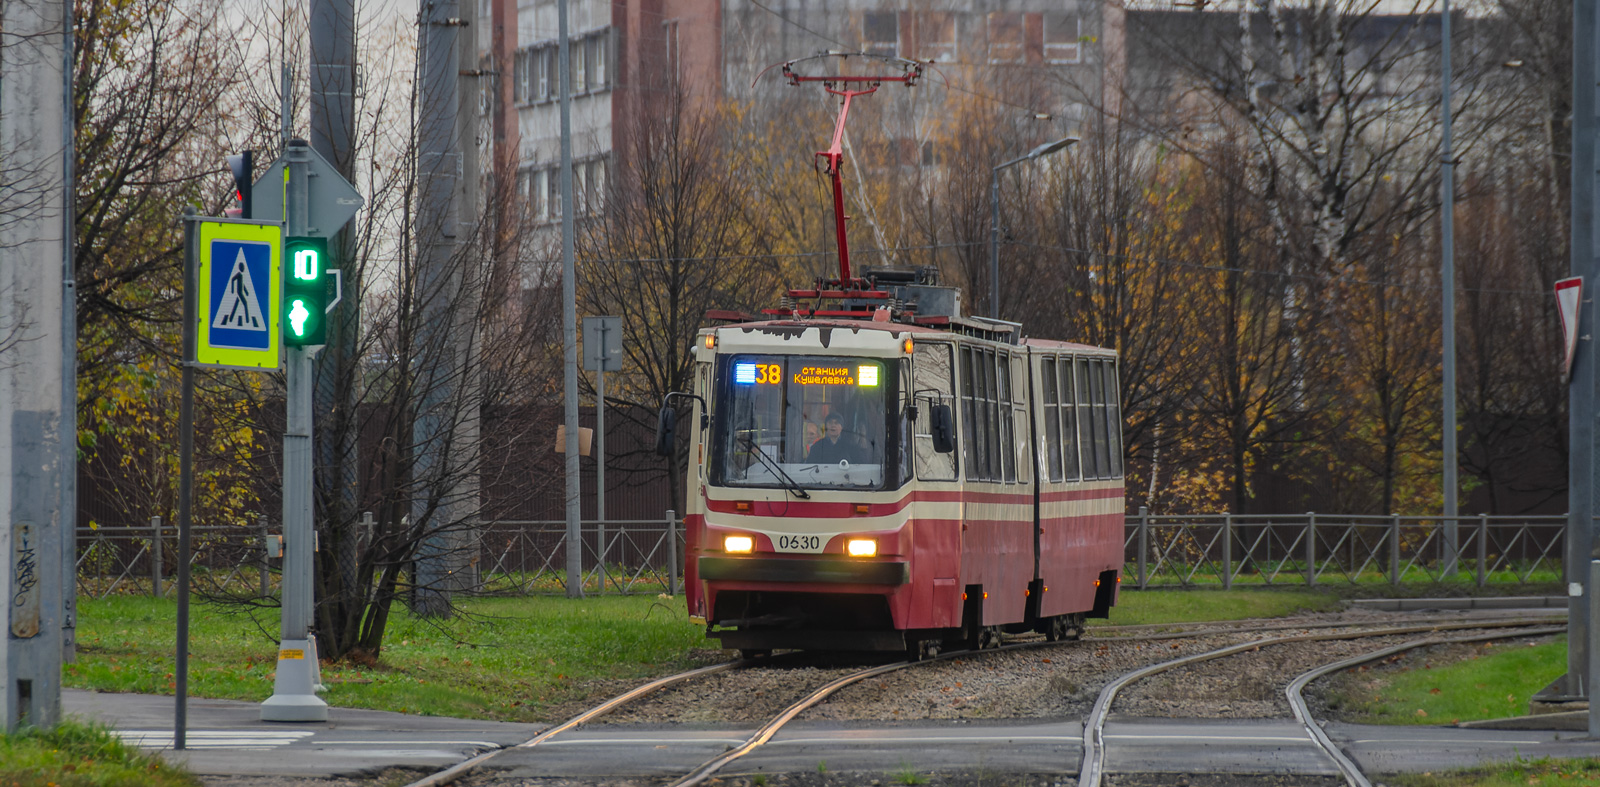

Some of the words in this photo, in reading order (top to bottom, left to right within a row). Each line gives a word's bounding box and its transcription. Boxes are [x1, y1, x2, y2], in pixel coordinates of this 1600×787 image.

[294, 249, 318, 280] 10
[755, 364, 781, 385] 38
[794, 373, 854, 385] Кушелевка
[779, 535, 820, 550] 0630
